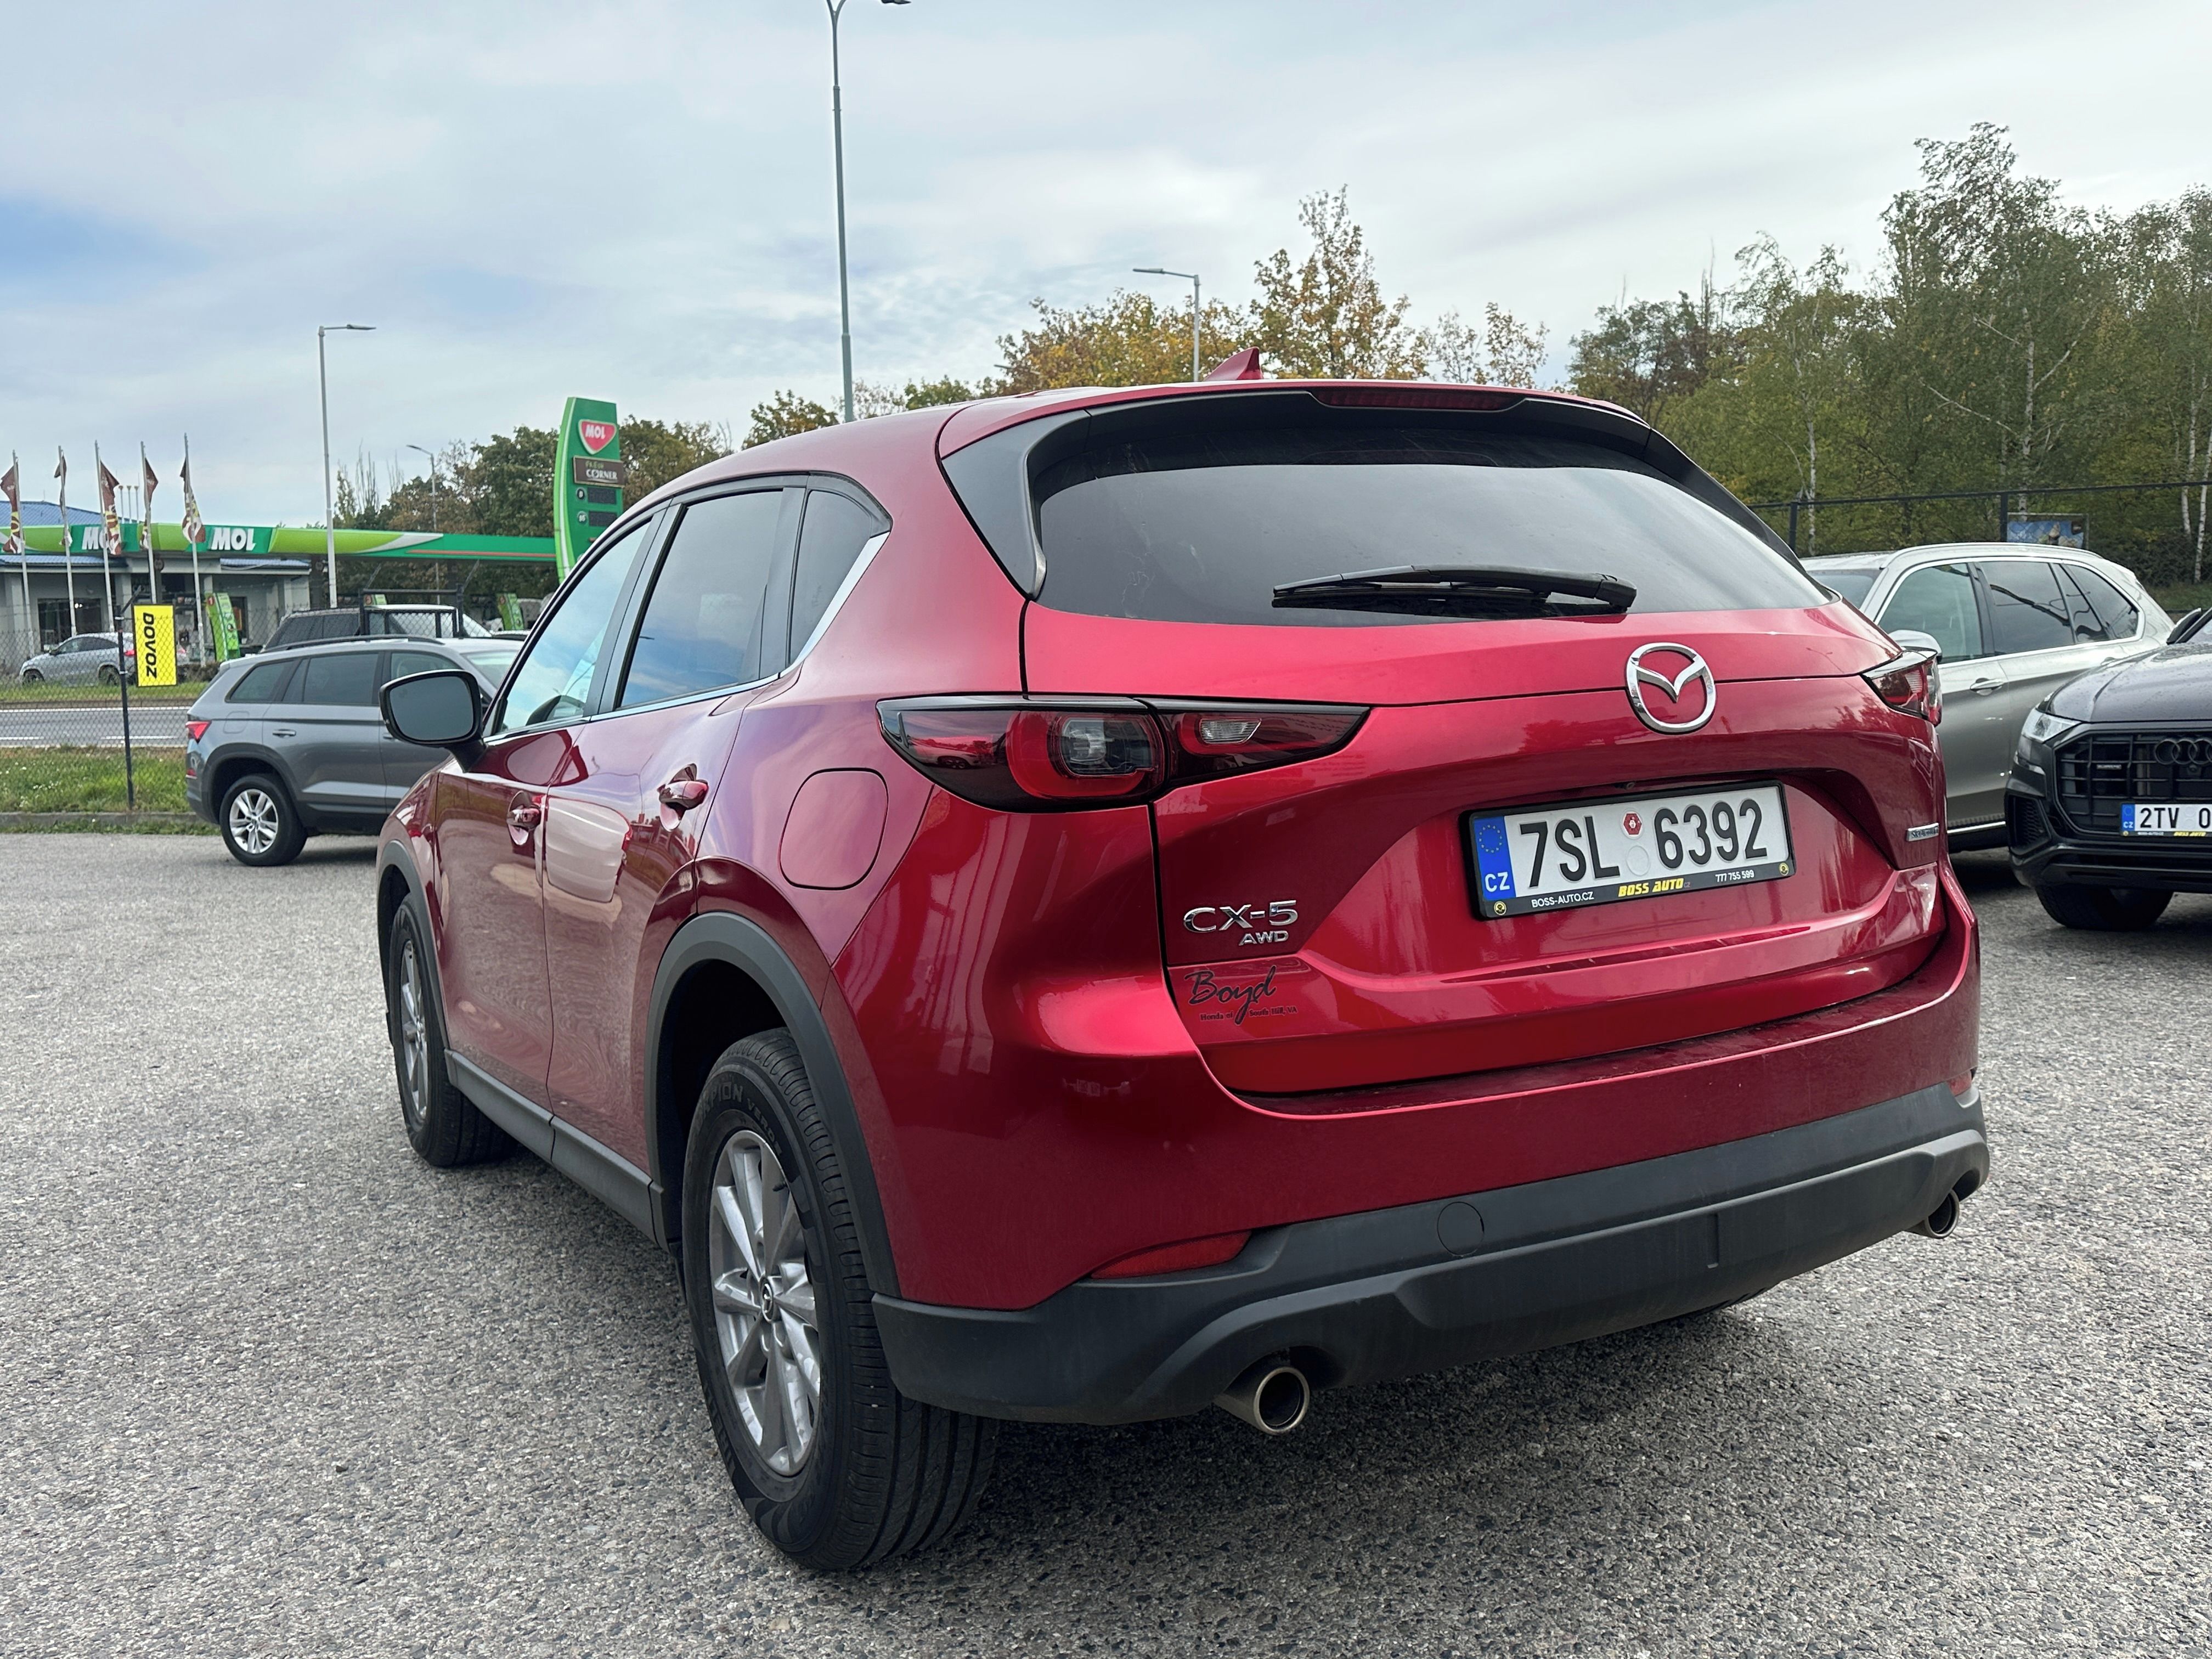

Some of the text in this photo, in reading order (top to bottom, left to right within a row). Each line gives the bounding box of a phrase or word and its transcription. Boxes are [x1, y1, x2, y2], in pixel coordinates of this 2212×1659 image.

[585, 424, 606, 439] MOL
[586, 469, 617, 480] CORNER
[211, 527, 256, 551] MOL
[143, 612, 157, 679] DOVOZ
[2140, 808, 2180, 828] 2TV
[1520, 799, 1768, 888] 7SL 6392
[1485, 871, 1510, 893] CZ
[1715, 873, 1727, 882] 777
[1728, 871, 1741, 881] 755
[1618, 883, 1649, 897] BOSS
[1652, 878, 1684, 893] AUTO
[1531, 891, 1595, 908] BOSS-AUTO.CZ
[1183, 900, 1299, 933] CX-5
[1238, 930, 1289, 946] AWD
[1184, 966, 1277, 1025] Boyd
[1200, 1012, 1224, 1020] Honda
[1286, 1005, 1298, 1014] VA
